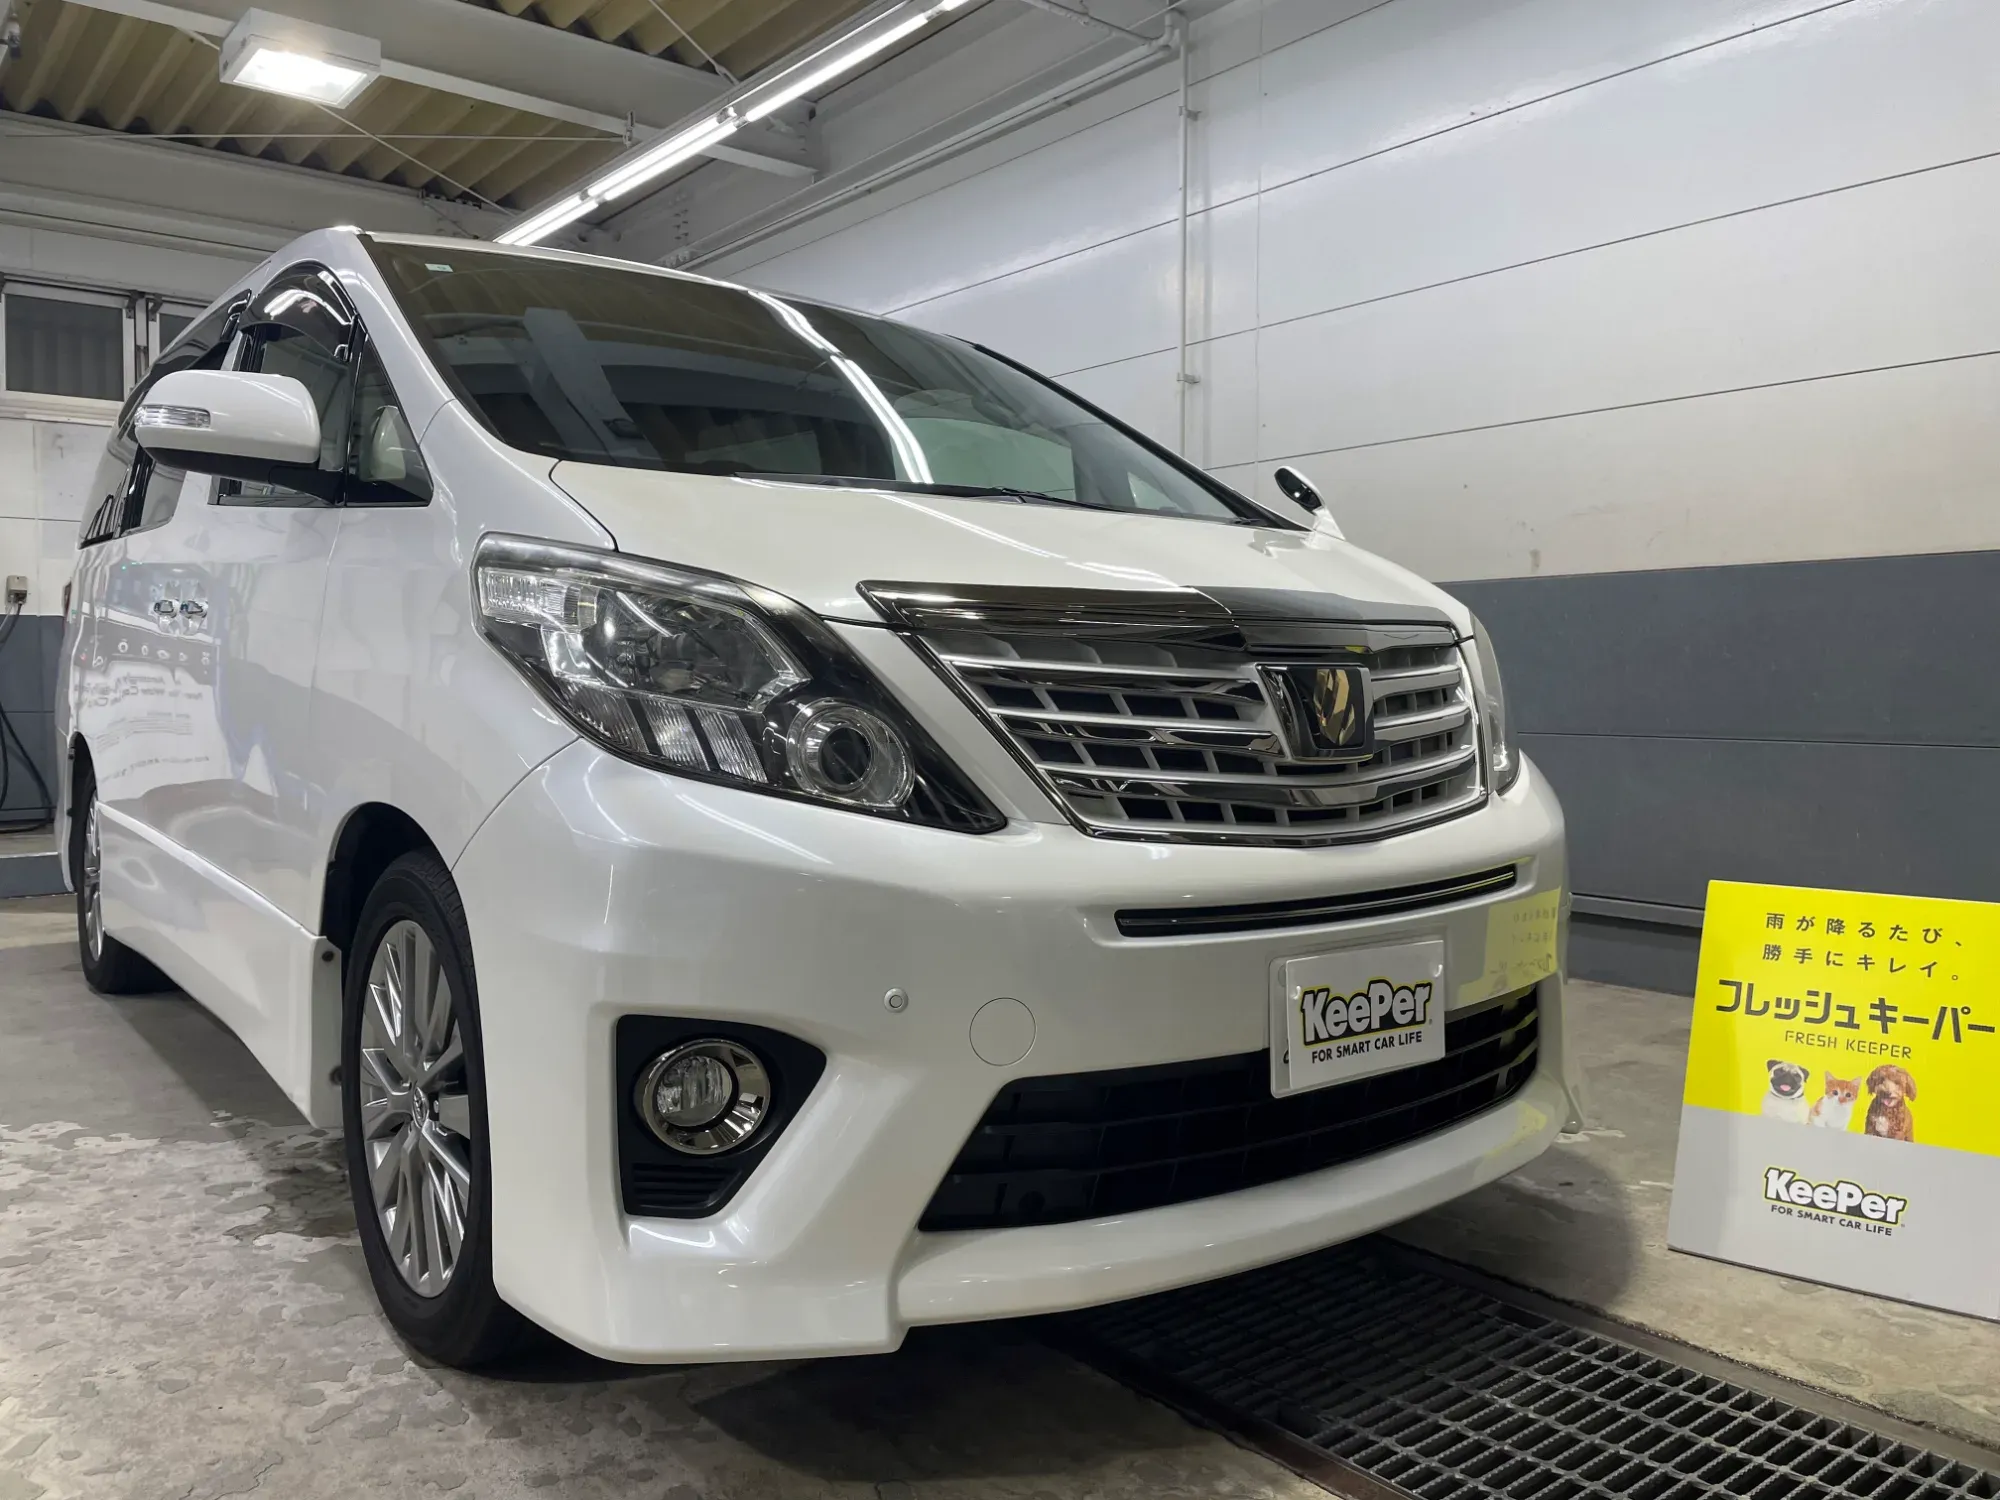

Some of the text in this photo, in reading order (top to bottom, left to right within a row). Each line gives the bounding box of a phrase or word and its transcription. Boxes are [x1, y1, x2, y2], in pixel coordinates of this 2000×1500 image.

[1765, 912, 1963, 947] 雨が降るたび、
[1762, 943, 1959, 981] 勝手にキレイ。
[1301, 979, 1432, 1046] KeePer
[1716, 978, 1995, 1043] フレッシュキーパー
[1312, 1030, 1422, 1064] FOR SMART CAR LIFE
[1785, 1030, 1912, 1059] FRESH KEEPER
[1764, 1167, 1907, 1225] KeePer
[1771, 1204, 1893, 1237] FOR SMART CAR LIFE
